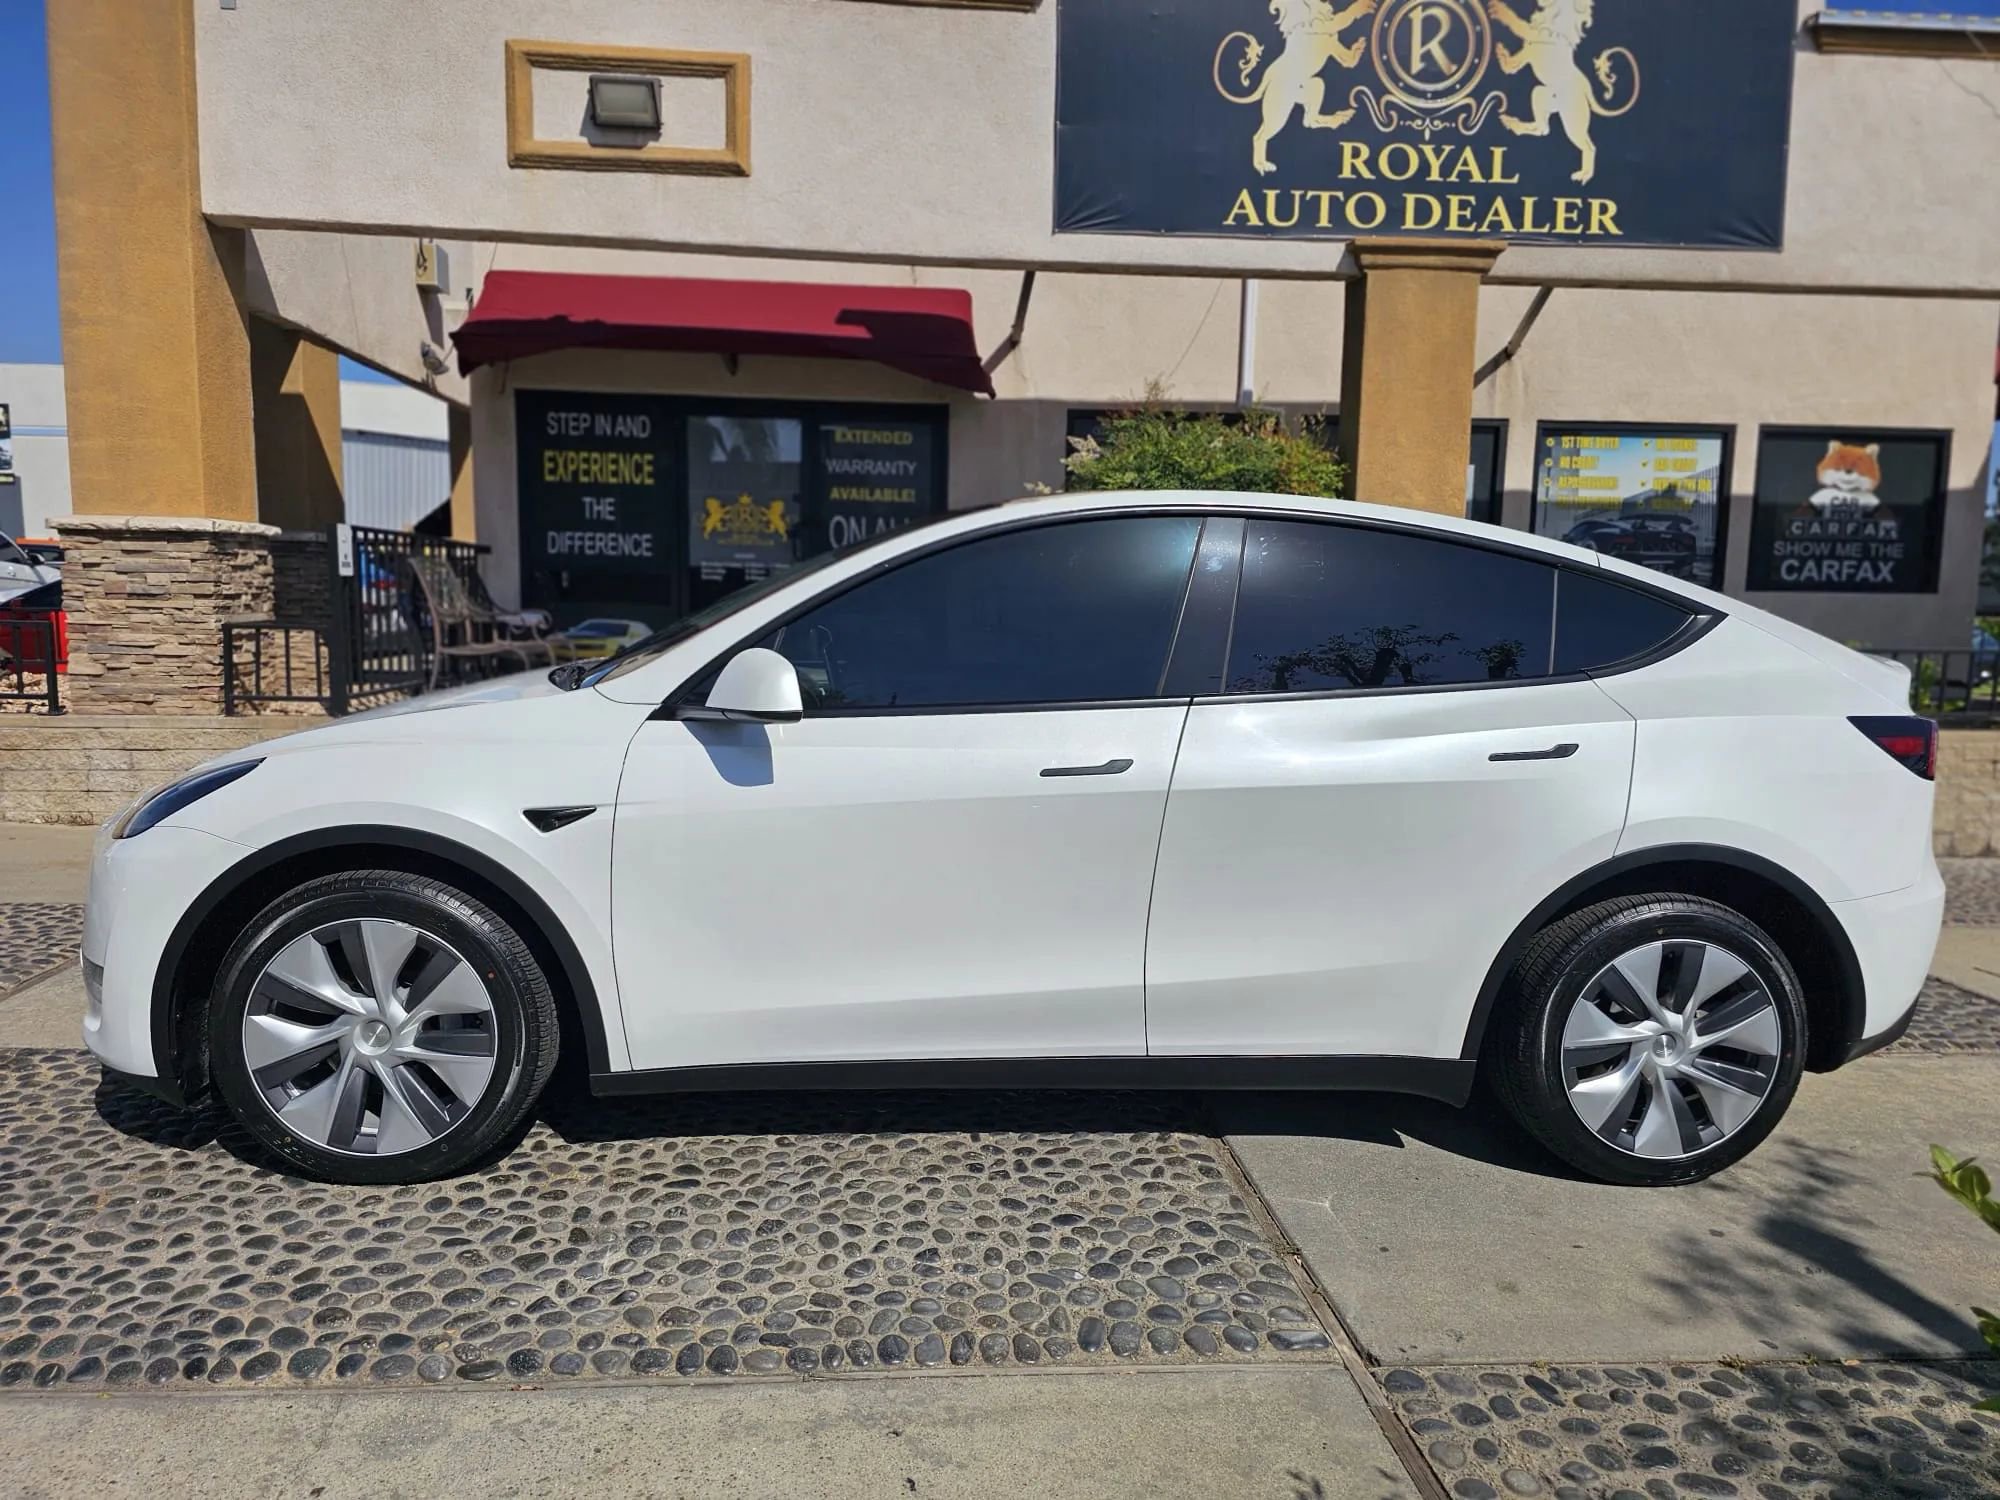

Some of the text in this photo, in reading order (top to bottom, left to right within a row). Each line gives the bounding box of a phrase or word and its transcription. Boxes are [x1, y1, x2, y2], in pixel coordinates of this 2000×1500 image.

[1408, 5, 1458, 76] R
[1338, 141, 1520, 185] ROYAL
[1223, 188, 1623, 236] AUTO DEALER
[546, 411, 651, 438] STEP IN AND
[834, 429, 913, 445] EXTENDED
[543, 449, 655, 486] EXPERIENCE
[825, 458, 917, 475] WARRANTY
[582, 496, 616, 521] THE
[546, 531, 653, 557] DIFFERENCE
[829, 515, 867, 549] ON
[1773, 540, 1904, 559] SHOW ME THE
[1781, 559, 1895, 582] CARFAX
